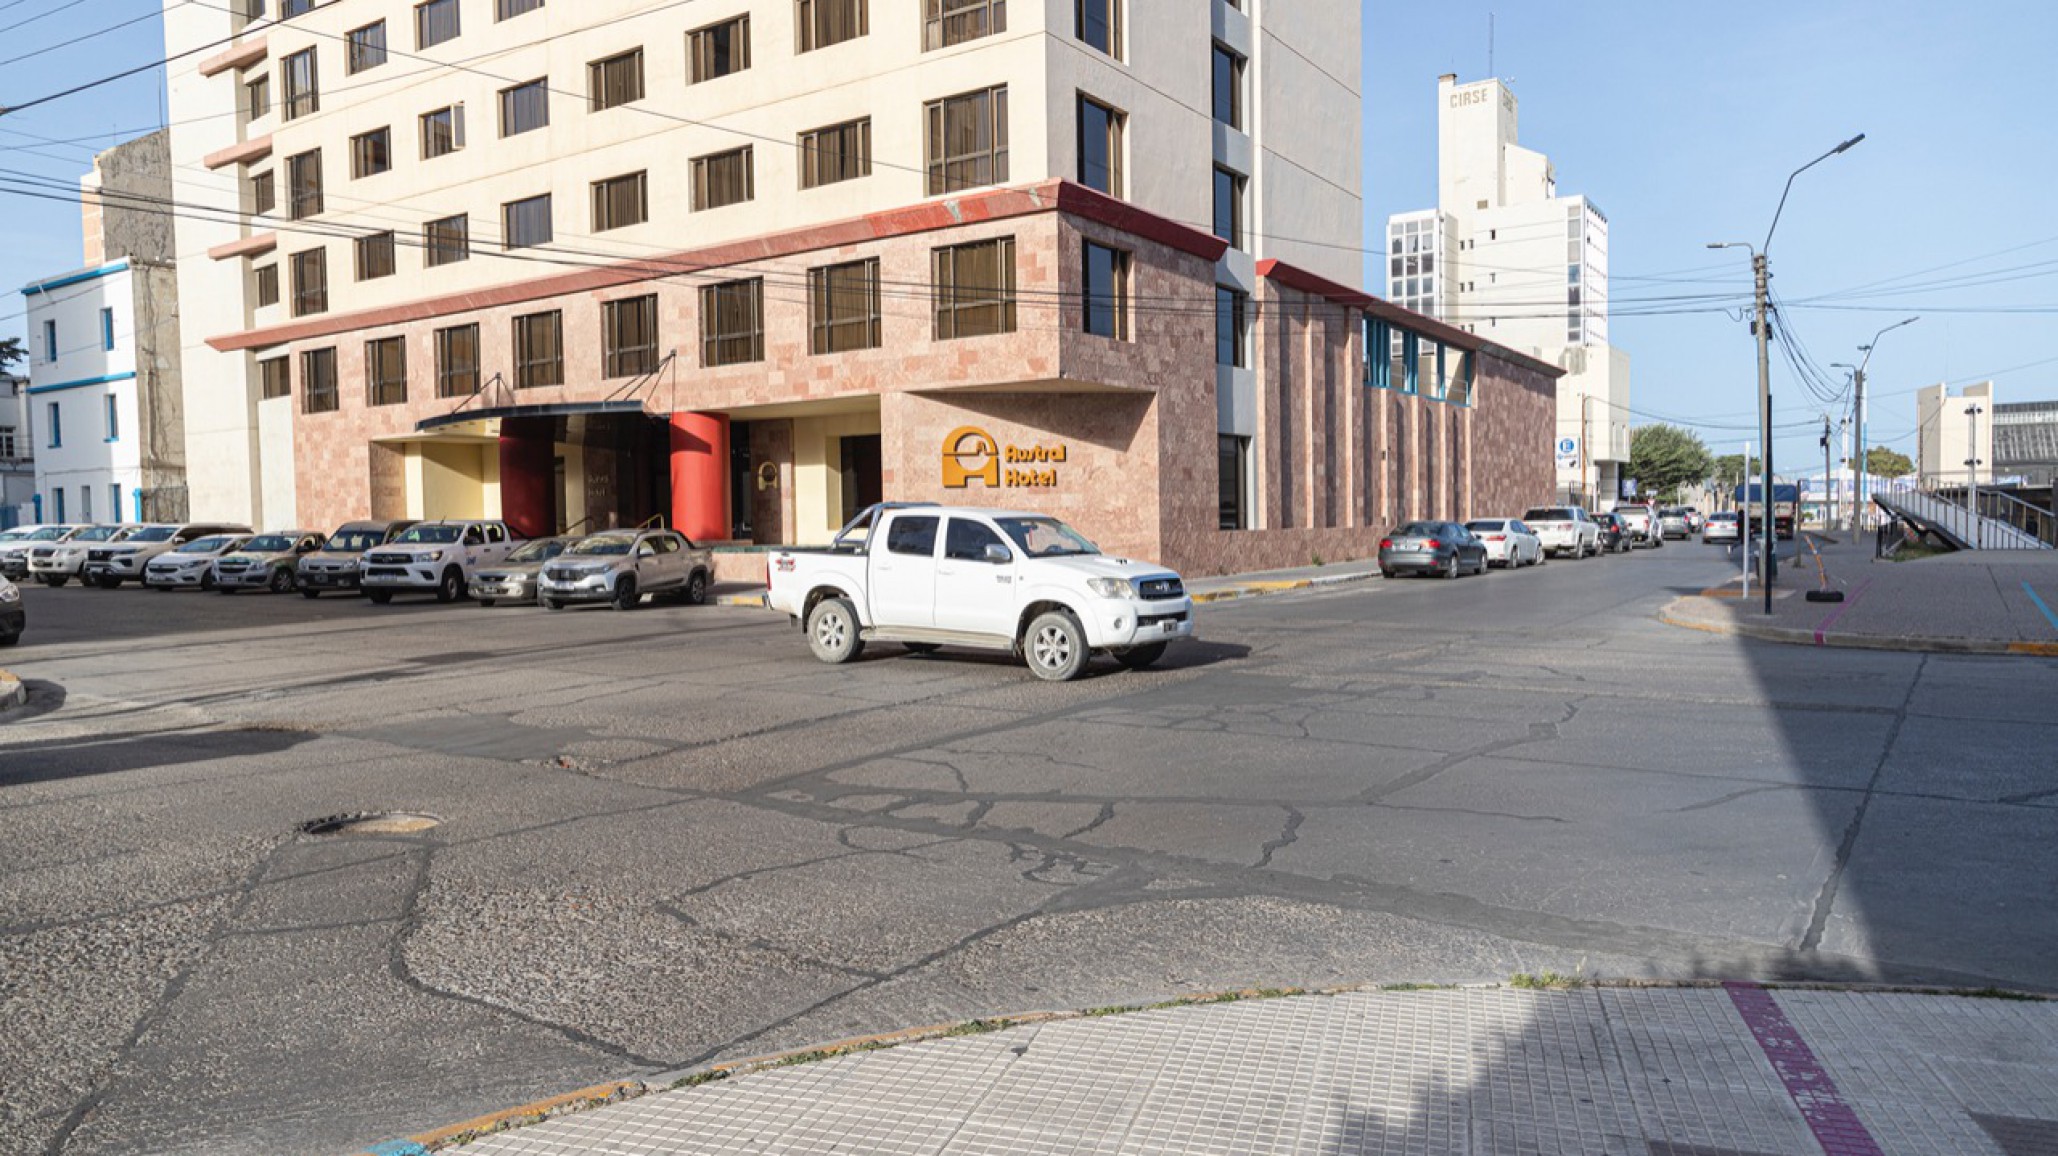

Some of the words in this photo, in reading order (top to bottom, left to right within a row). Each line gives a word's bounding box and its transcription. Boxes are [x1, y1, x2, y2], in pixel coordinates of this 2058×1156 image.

[1450, 88, 1488, 108] CIRSE
[1005, 444, 1066, 462] Austral
[1005, 468, 1057, 488] Hotel
